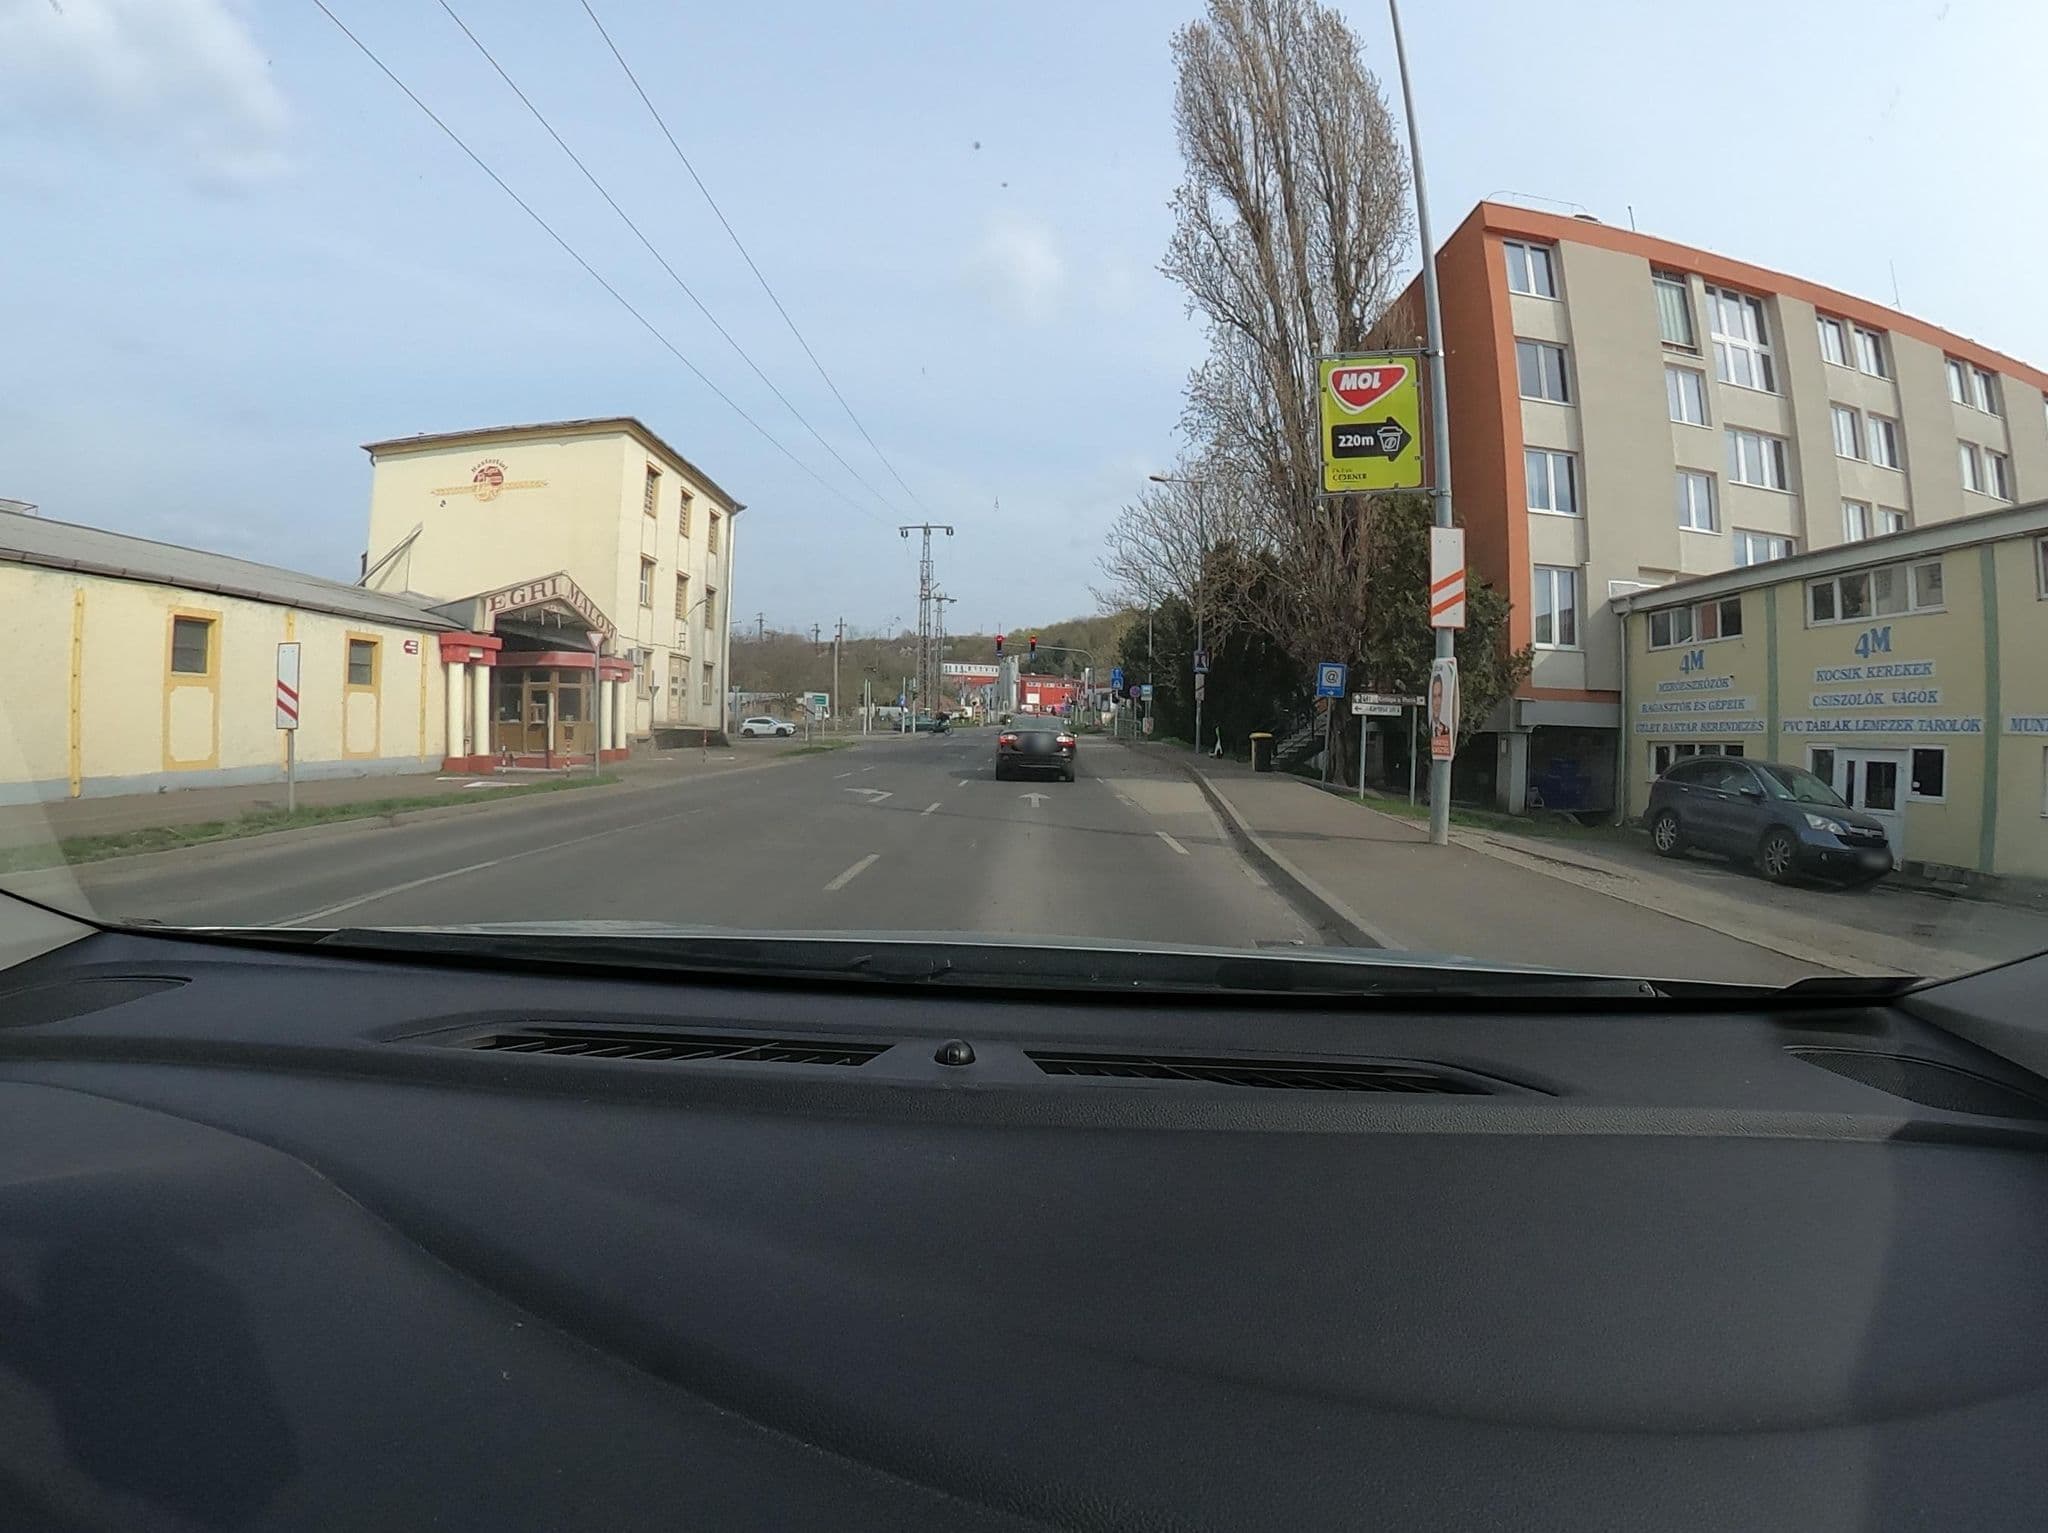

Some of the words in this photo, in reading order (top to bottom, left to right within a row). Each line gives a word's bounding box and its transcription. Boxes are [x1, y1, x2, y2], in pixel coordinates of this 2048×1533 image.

[1339, 372, 1381, 390] MOL
[1338, 435, 1374, 447] 220m
[489, 578, 559, 612] EGRI
[567, 583, 616, 638] MALOM
[1855, 626, 1892, 659] 4M
[1679, 649, 1705, 674] 4M
[1816, 667, 1862, 682] KOCSIK
[1866, 662, 1933, 678] KEREKEK
[2010, 717, 2048, 732] MUN
